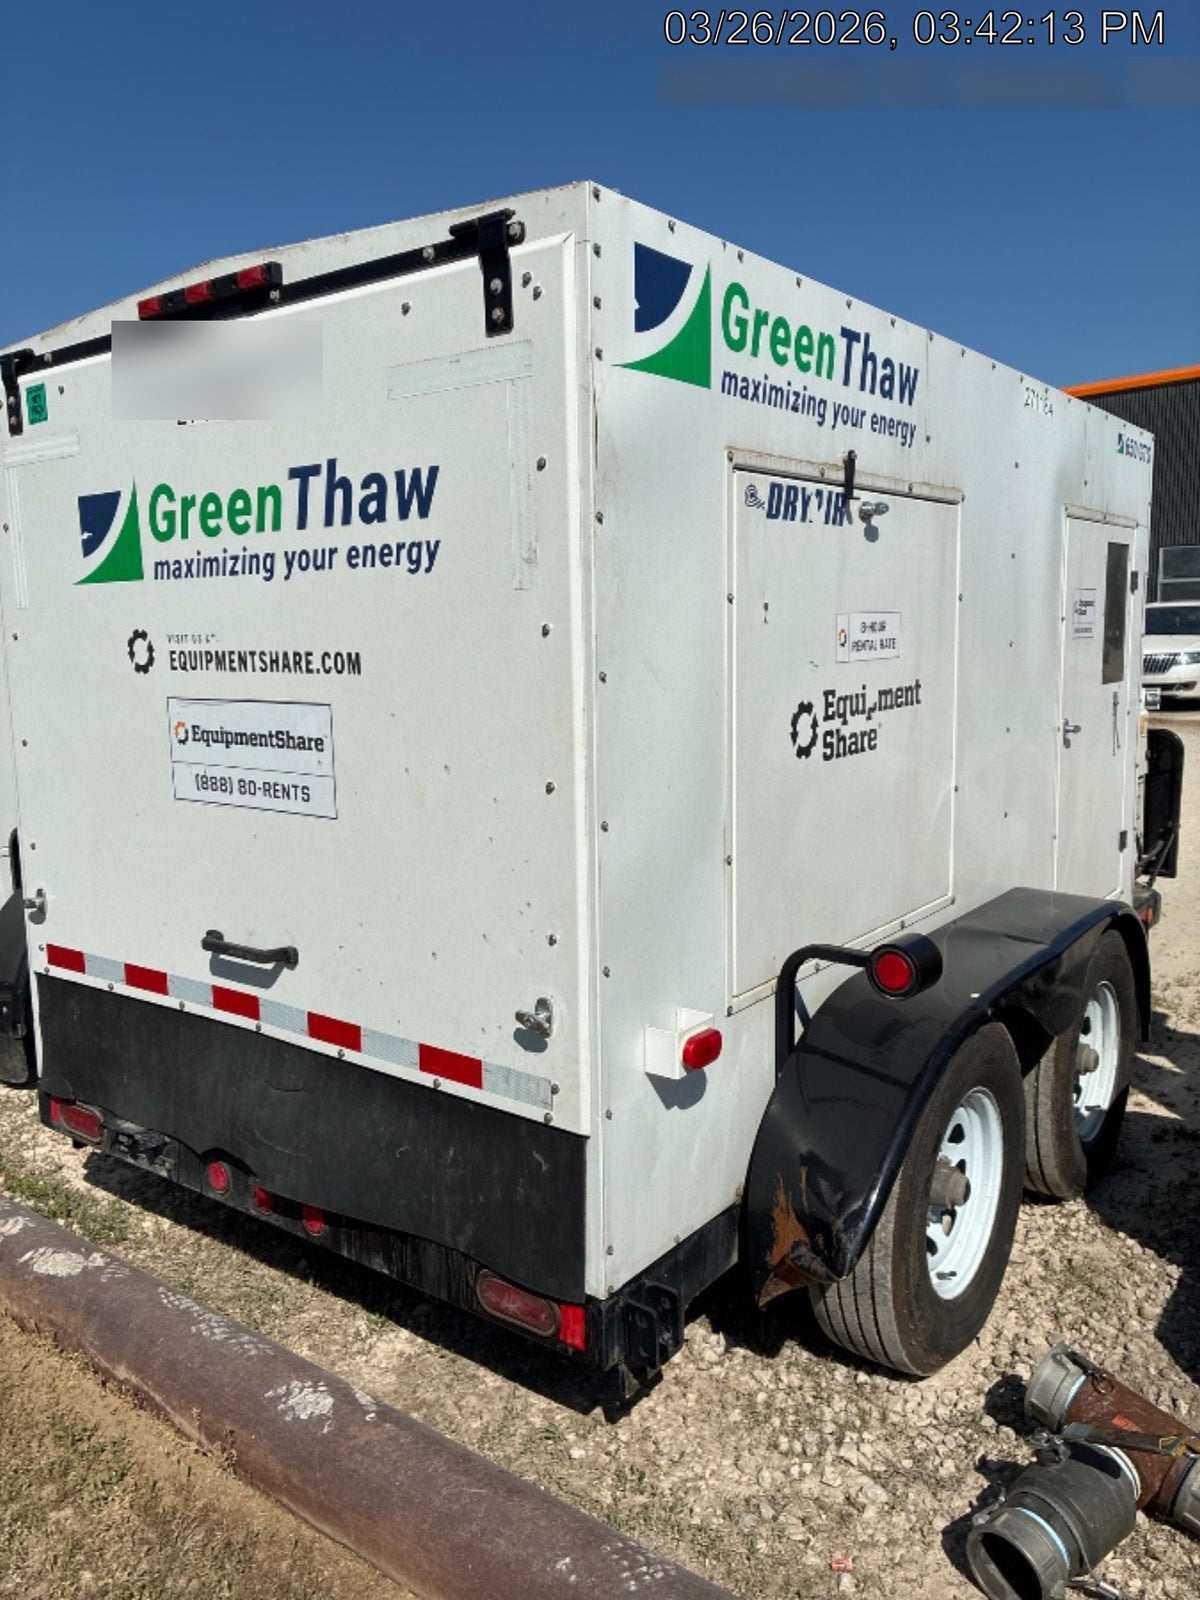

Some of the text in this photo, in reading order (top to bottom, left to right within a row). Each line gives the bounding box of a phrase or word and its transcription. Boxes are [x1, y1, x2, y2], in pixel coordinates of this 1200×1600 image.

[721, 369, 917, 449] maximizing your energy
[154, 539, 442, 583] maximizing your energy
[169, 650, 362, 676] EQUIPMENTSHARE.COM
[191, 724, 325, 752] EquipmentShare
[822, 728, 878, 761] Share
[195, 772, 311, 803] (888) 80-RENTS
